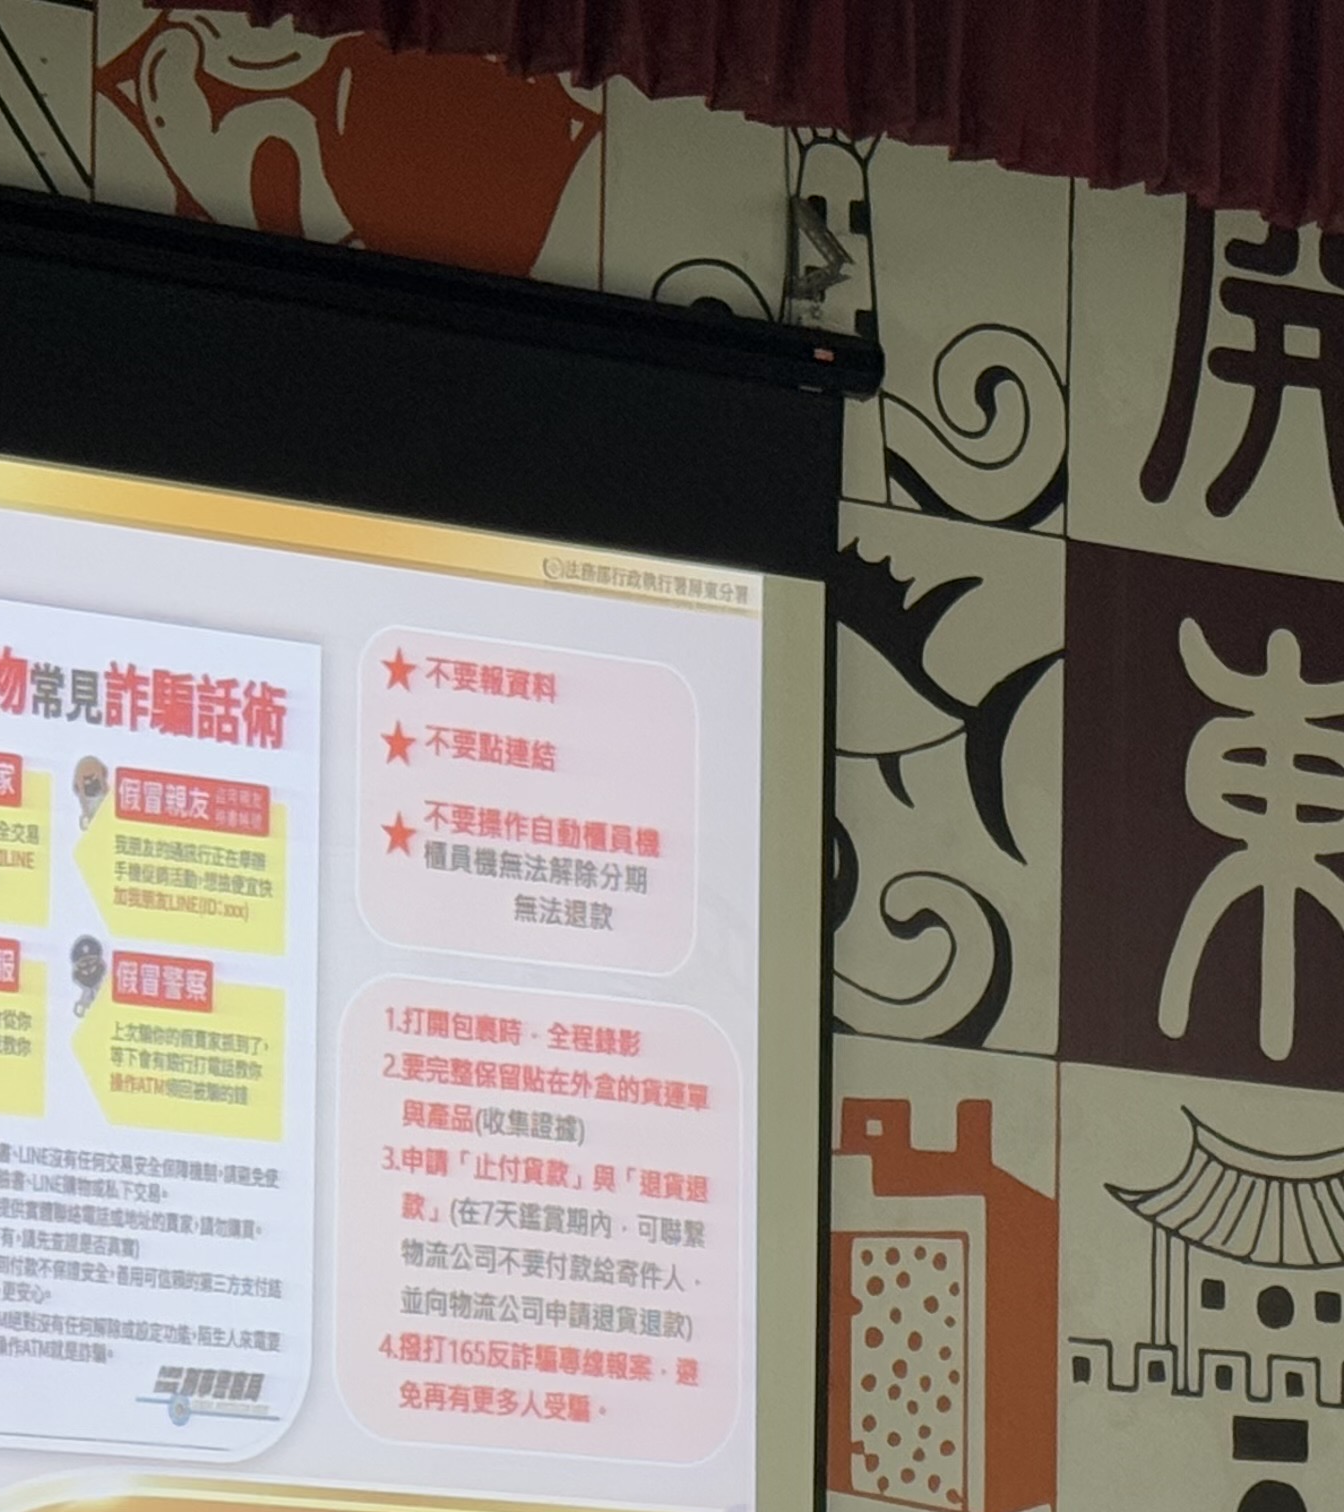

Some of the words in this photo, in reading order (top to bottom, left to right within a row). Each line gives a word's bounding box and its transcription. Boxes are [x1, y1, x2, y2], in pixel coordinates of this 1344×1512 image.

[424, 656, 557, 703] 不要報資料
[424, 724, 557, 772] 不要點連結
[118, 778, 210, 821] 假冒親友
[424, 800, 662, 859] 不要操作自動櫃員機
[424, 840, 649, 895] 櫃員機無法解除分期
[514, 894, 614, 931] 無法退款
[116, 961, 208, 1002] 假冒警察
[399, 1285, 693, 1342] 並向物流公司申請退貨退款)
[399, 1379, 608, 1423] 免再有更多人受騙。
